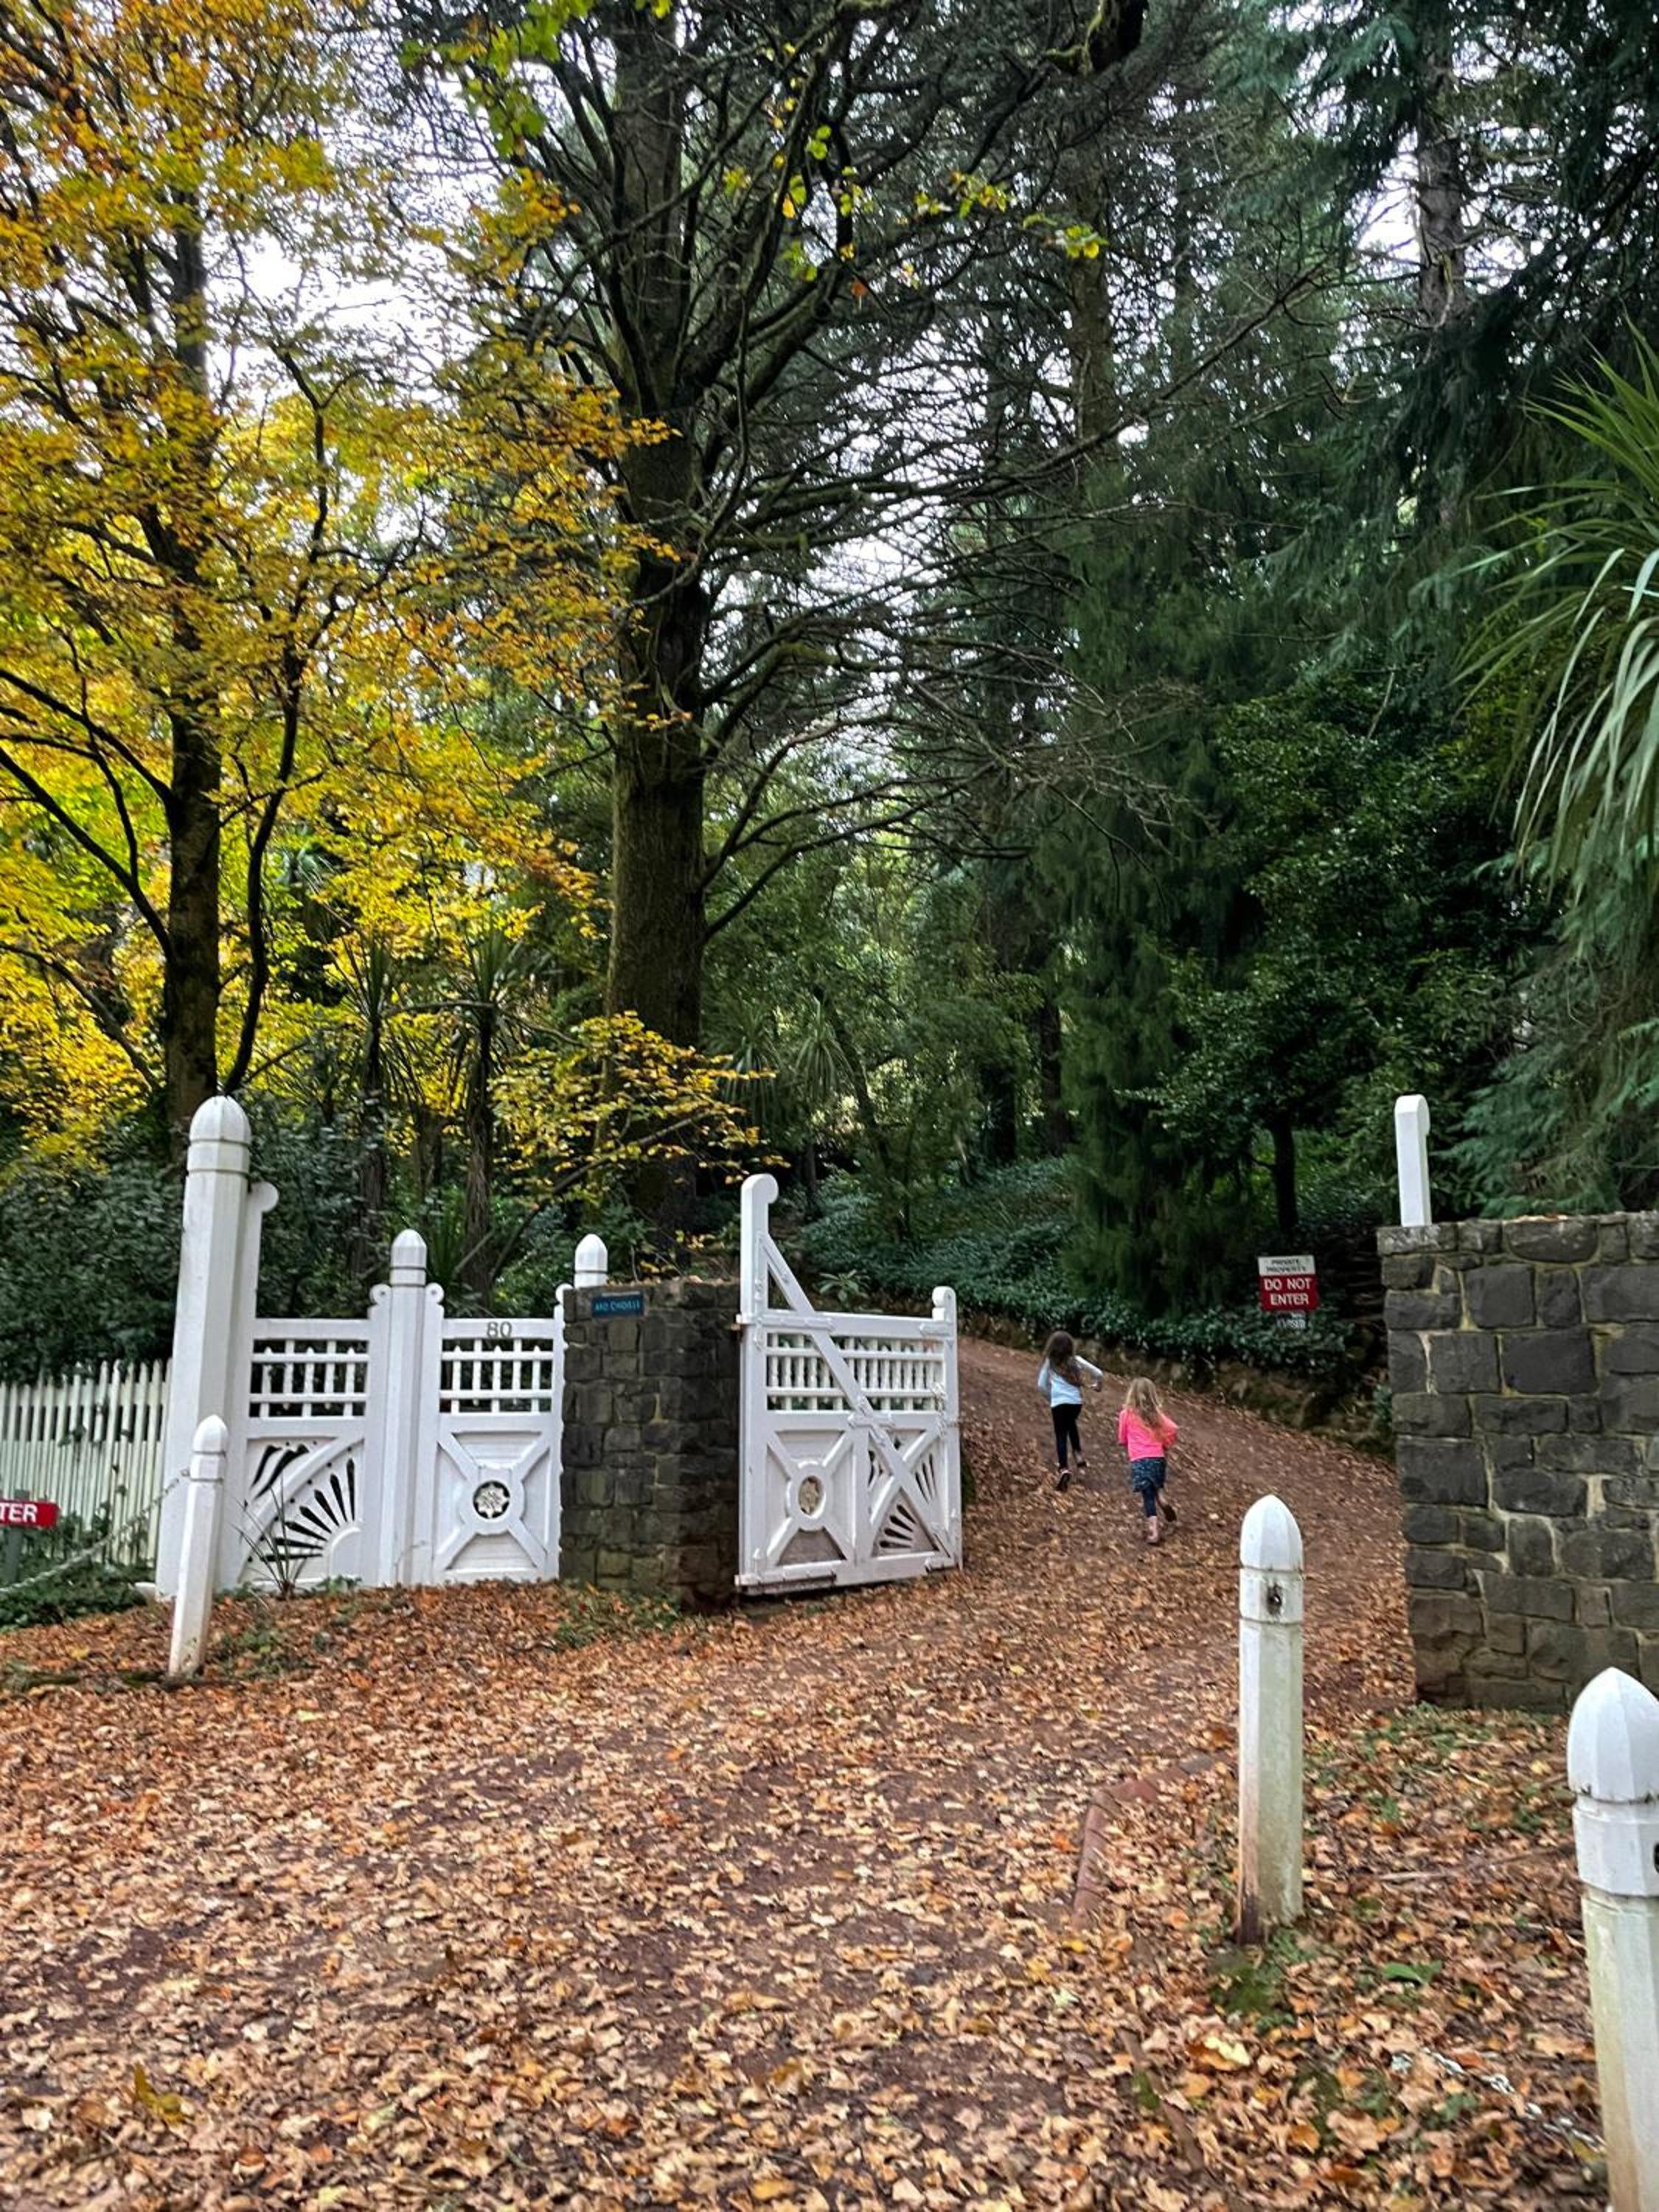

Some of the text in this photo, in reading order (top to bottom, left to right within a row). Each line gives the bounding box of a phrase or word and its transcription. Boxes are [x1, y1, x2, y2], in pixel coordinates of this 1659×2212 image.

[1263, 1278, 1312, 1291] DO NOT
[1270, 1293, 1310, 1306] ENTER
[487, 1321, 512, 1339] 80
